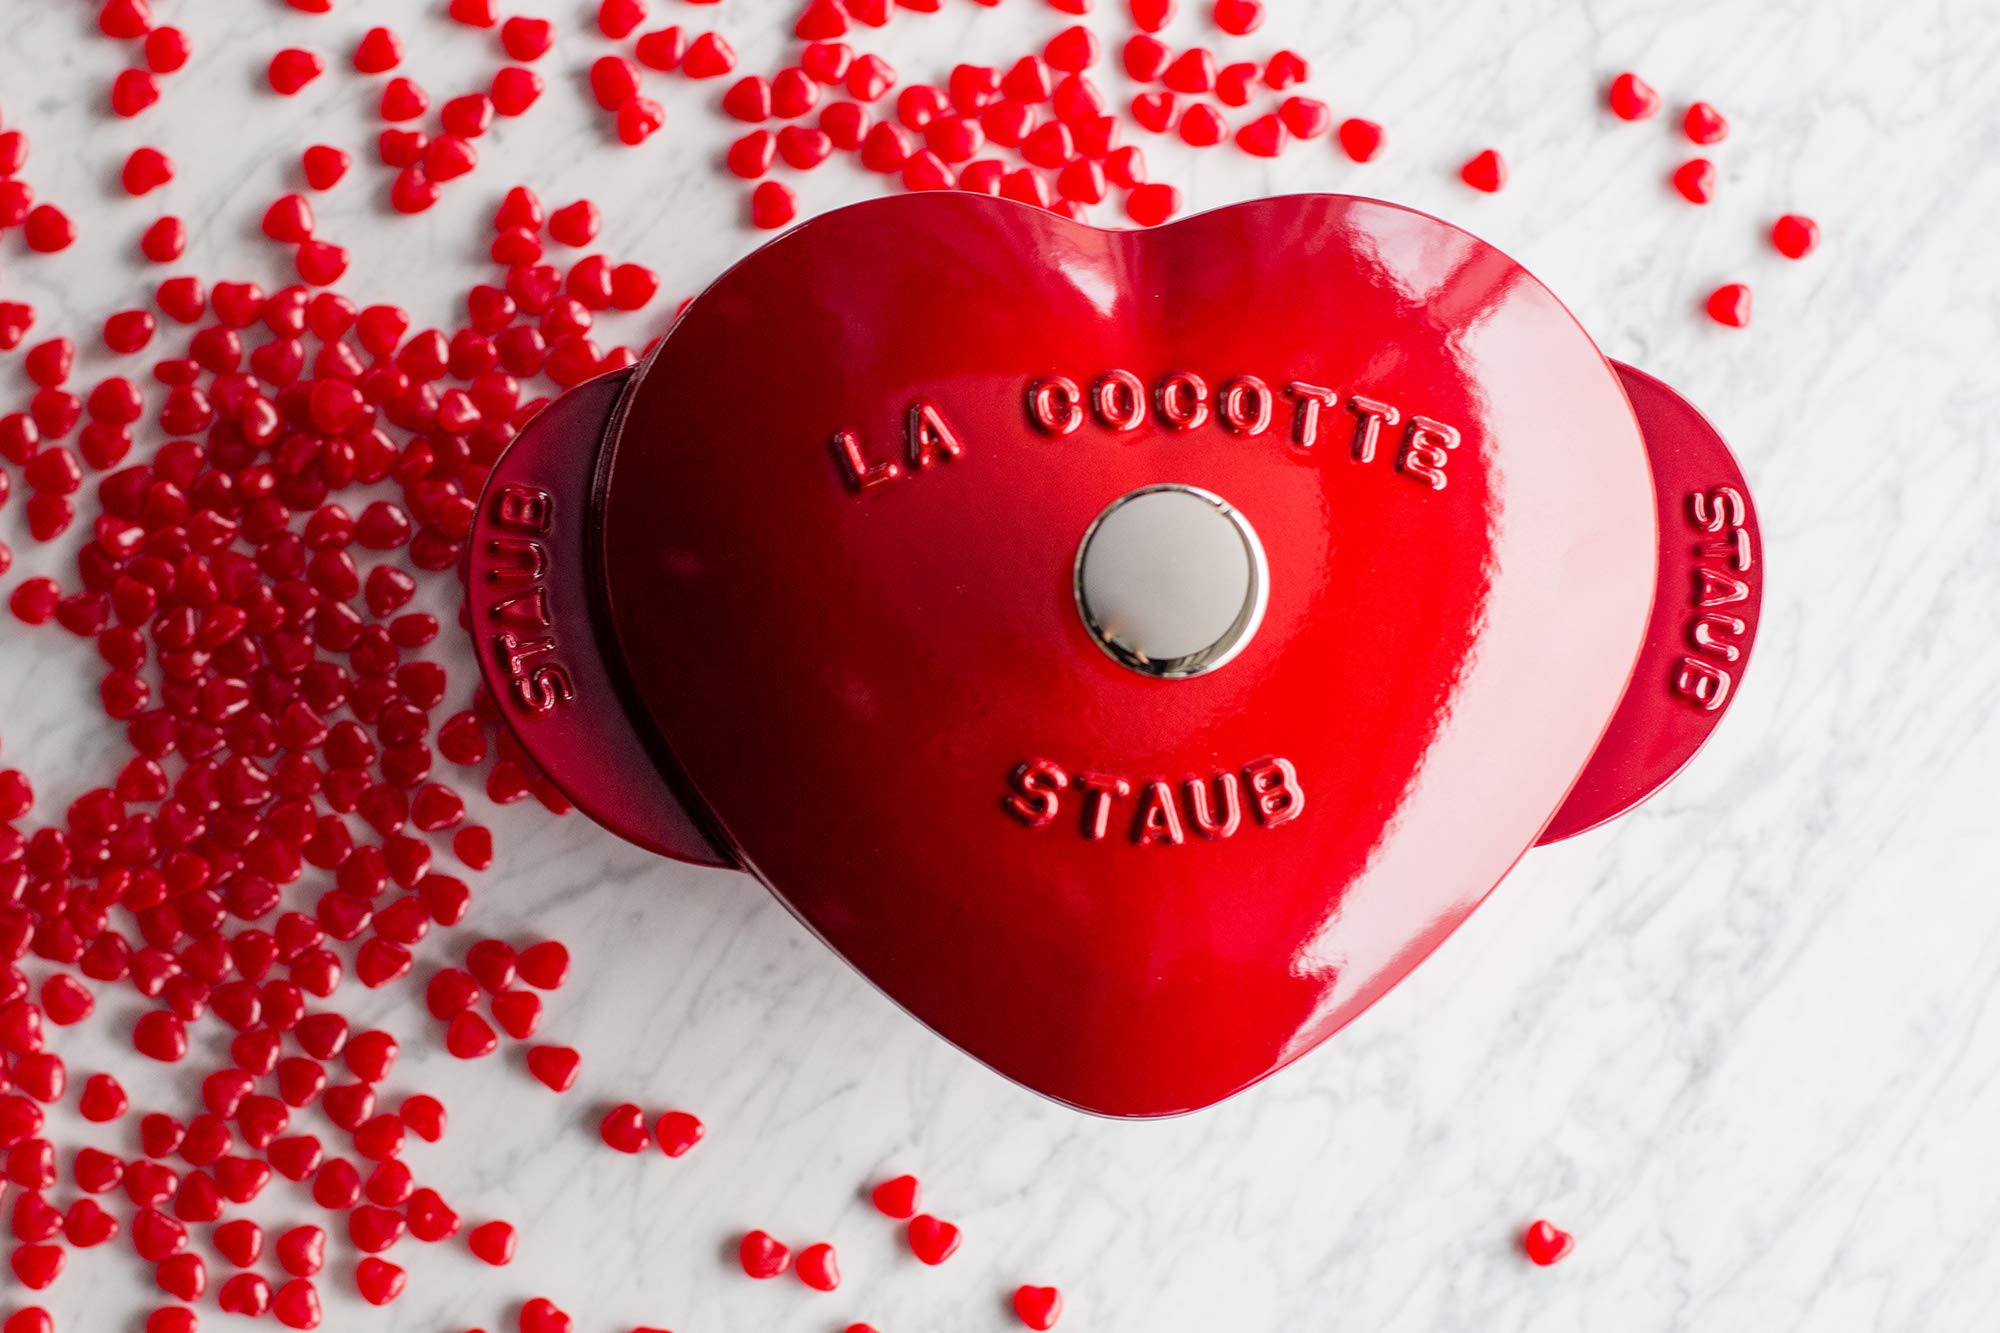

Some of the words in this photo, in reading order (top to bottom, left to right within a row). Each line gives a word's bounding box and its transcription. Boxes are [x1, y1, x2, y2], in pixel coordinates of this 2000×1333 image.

[831, 400, 963, 490] LA
[1028, 369, 1462, 491] COCOTTE
[487, 484, 575, 713] STAUB
[1671, 486, 1752, 711] STAUB
[1004, 755, 1306, 845] STAUB
